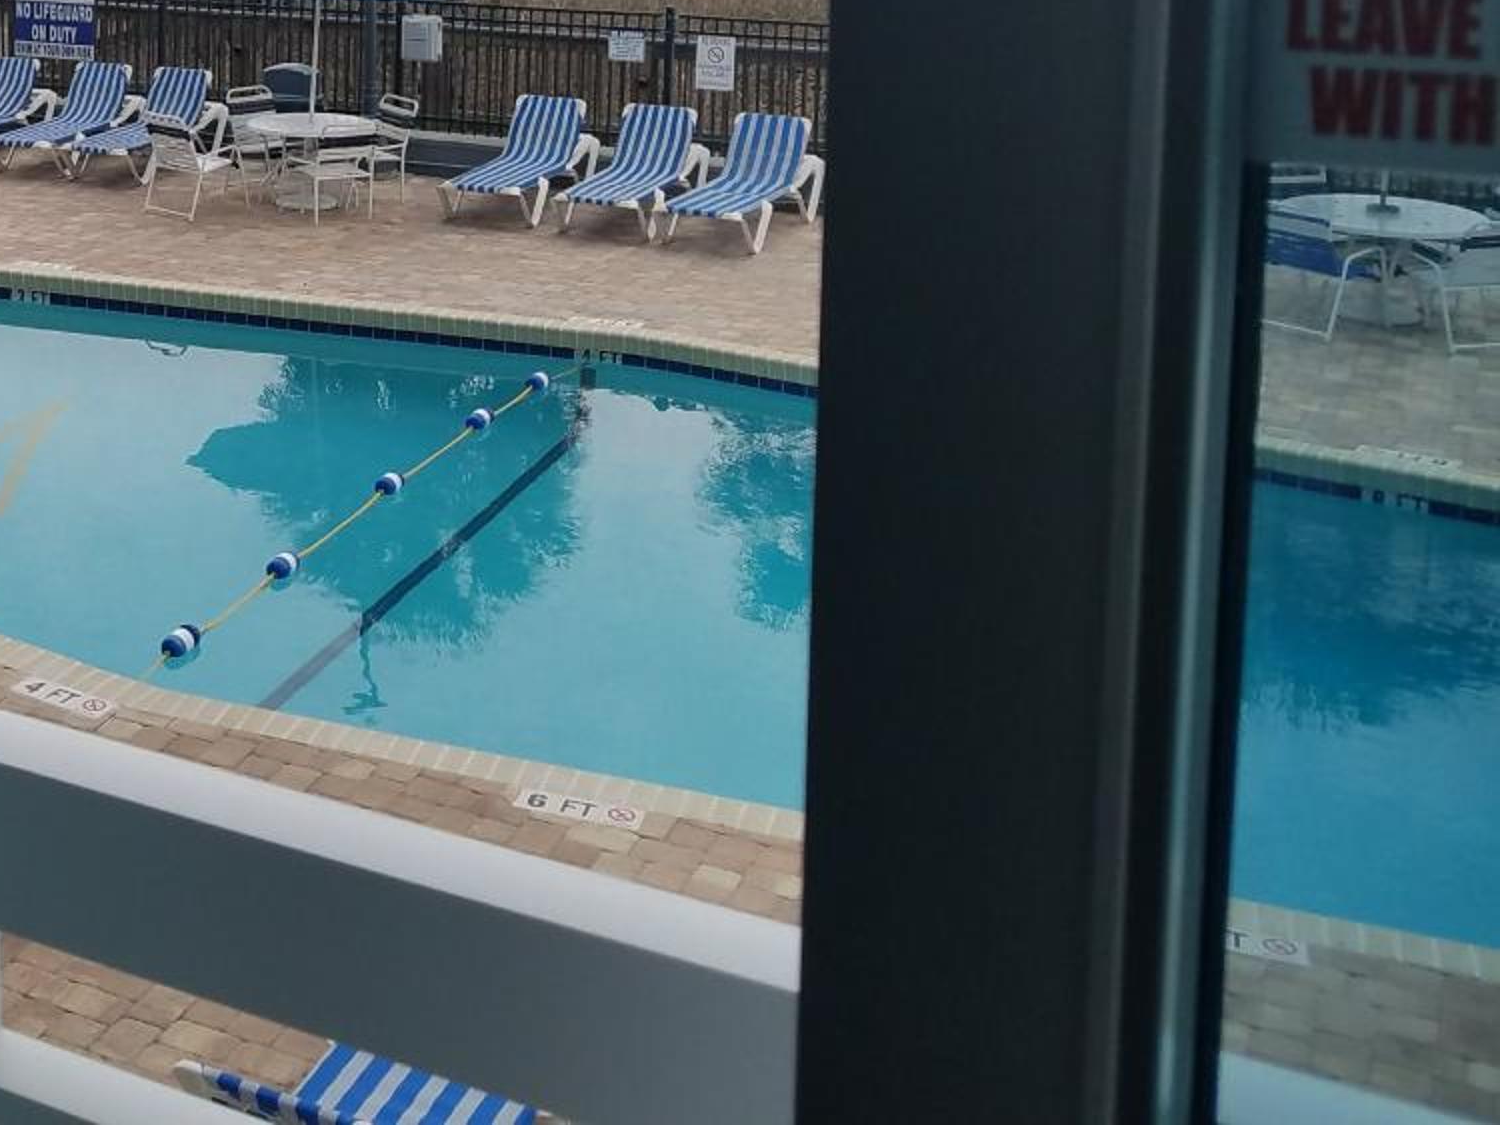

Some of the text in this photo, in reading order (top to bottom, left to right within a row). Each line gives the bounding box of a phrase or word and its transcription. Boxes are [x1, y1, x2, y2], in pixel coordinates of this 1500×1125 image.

[15, 2, 93, 23] NO LIFEGUARD
[31, 24, 77, 44] ON DUTY
[1308, 65, 1496, 147] WITH
[25, 682, 83, 704] 4 FT
[527, 794, 597, 817] 6 FT
